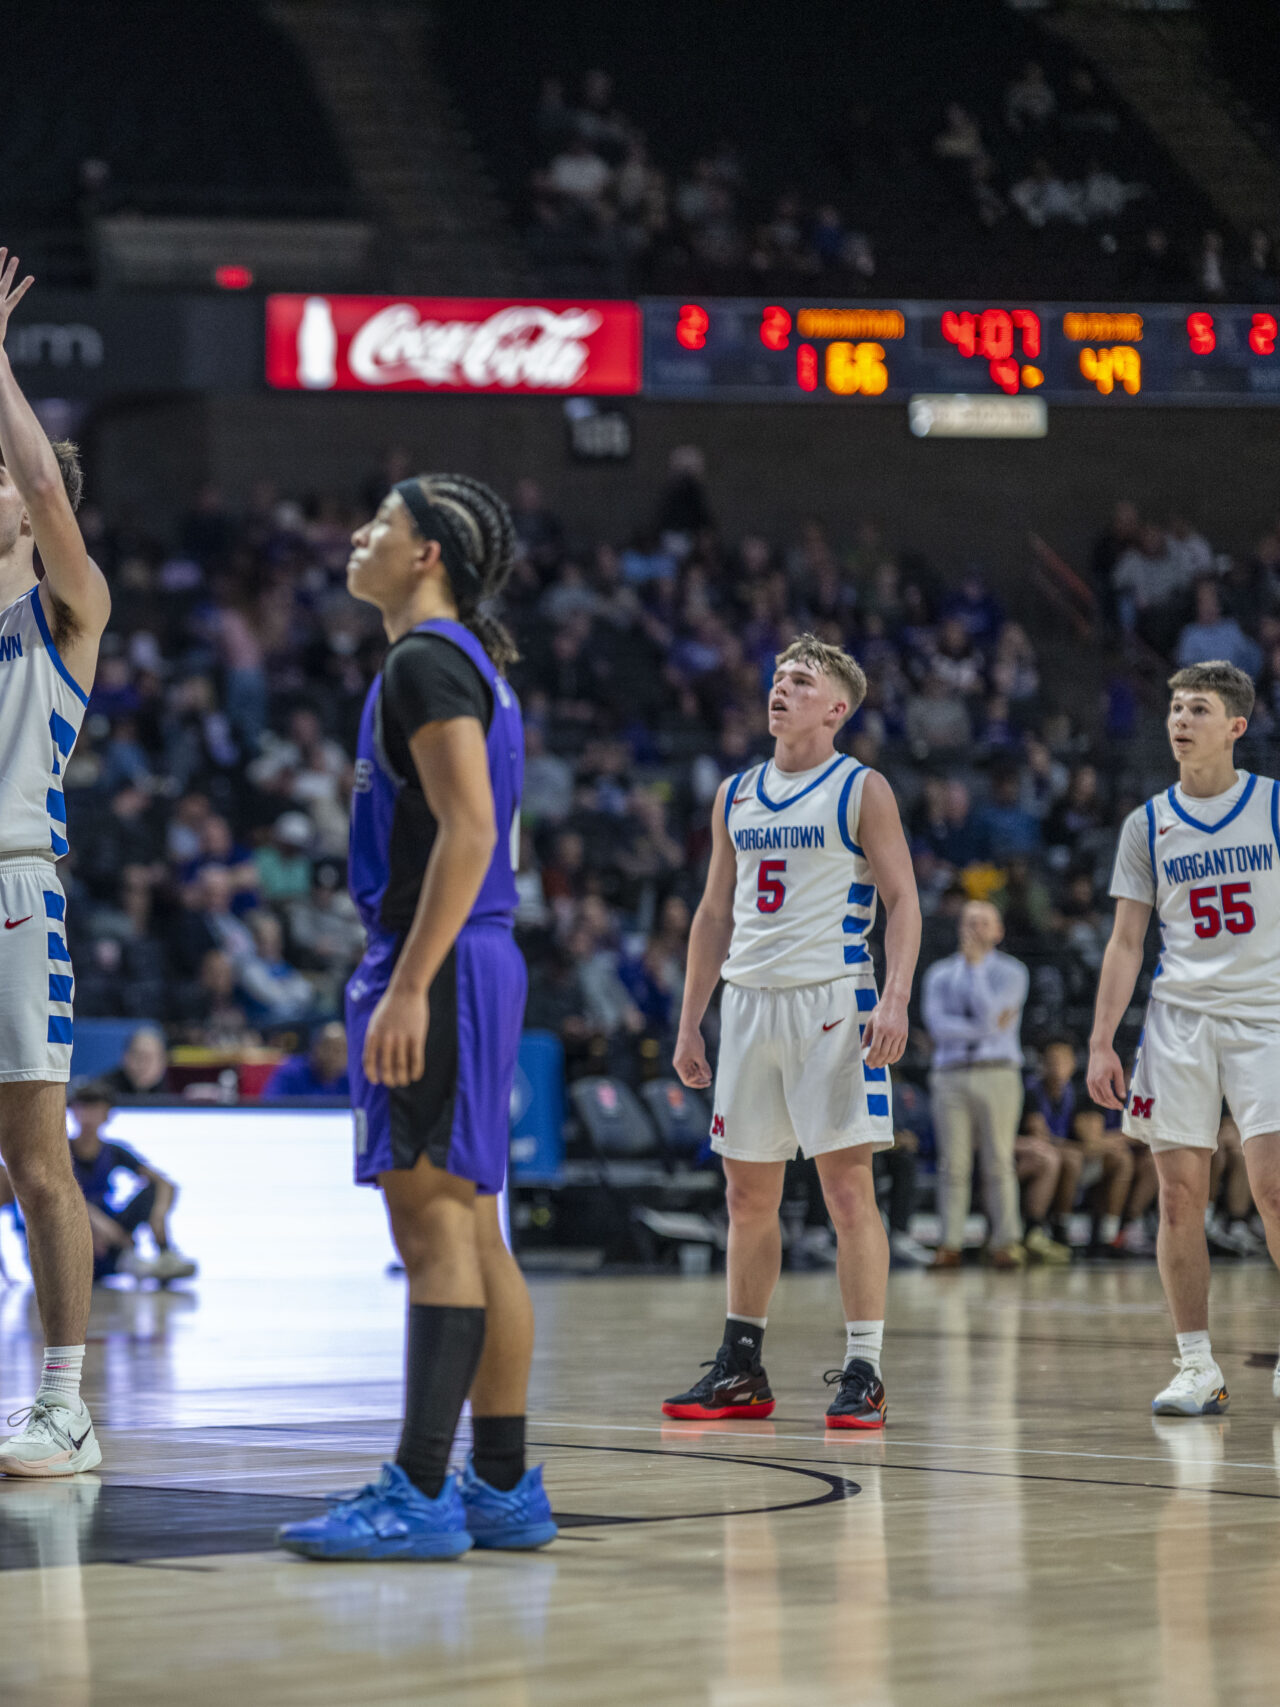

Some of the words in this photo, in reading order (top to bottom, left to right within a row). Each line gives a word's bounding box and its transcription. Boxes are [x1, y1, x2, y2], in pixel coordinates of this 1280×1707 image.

[825, 341, 888, 396] 66
[1079, 346, 1141, 395] 49
[733, 825, 825, 851] MORGANTOWN
[756, 859, 787, 914] 5
[1163, 843, 1273, 886] MORGANTOWN
[1189, 881, 1256, 939] 55
[1131, 1095, 1155, 1119] M
